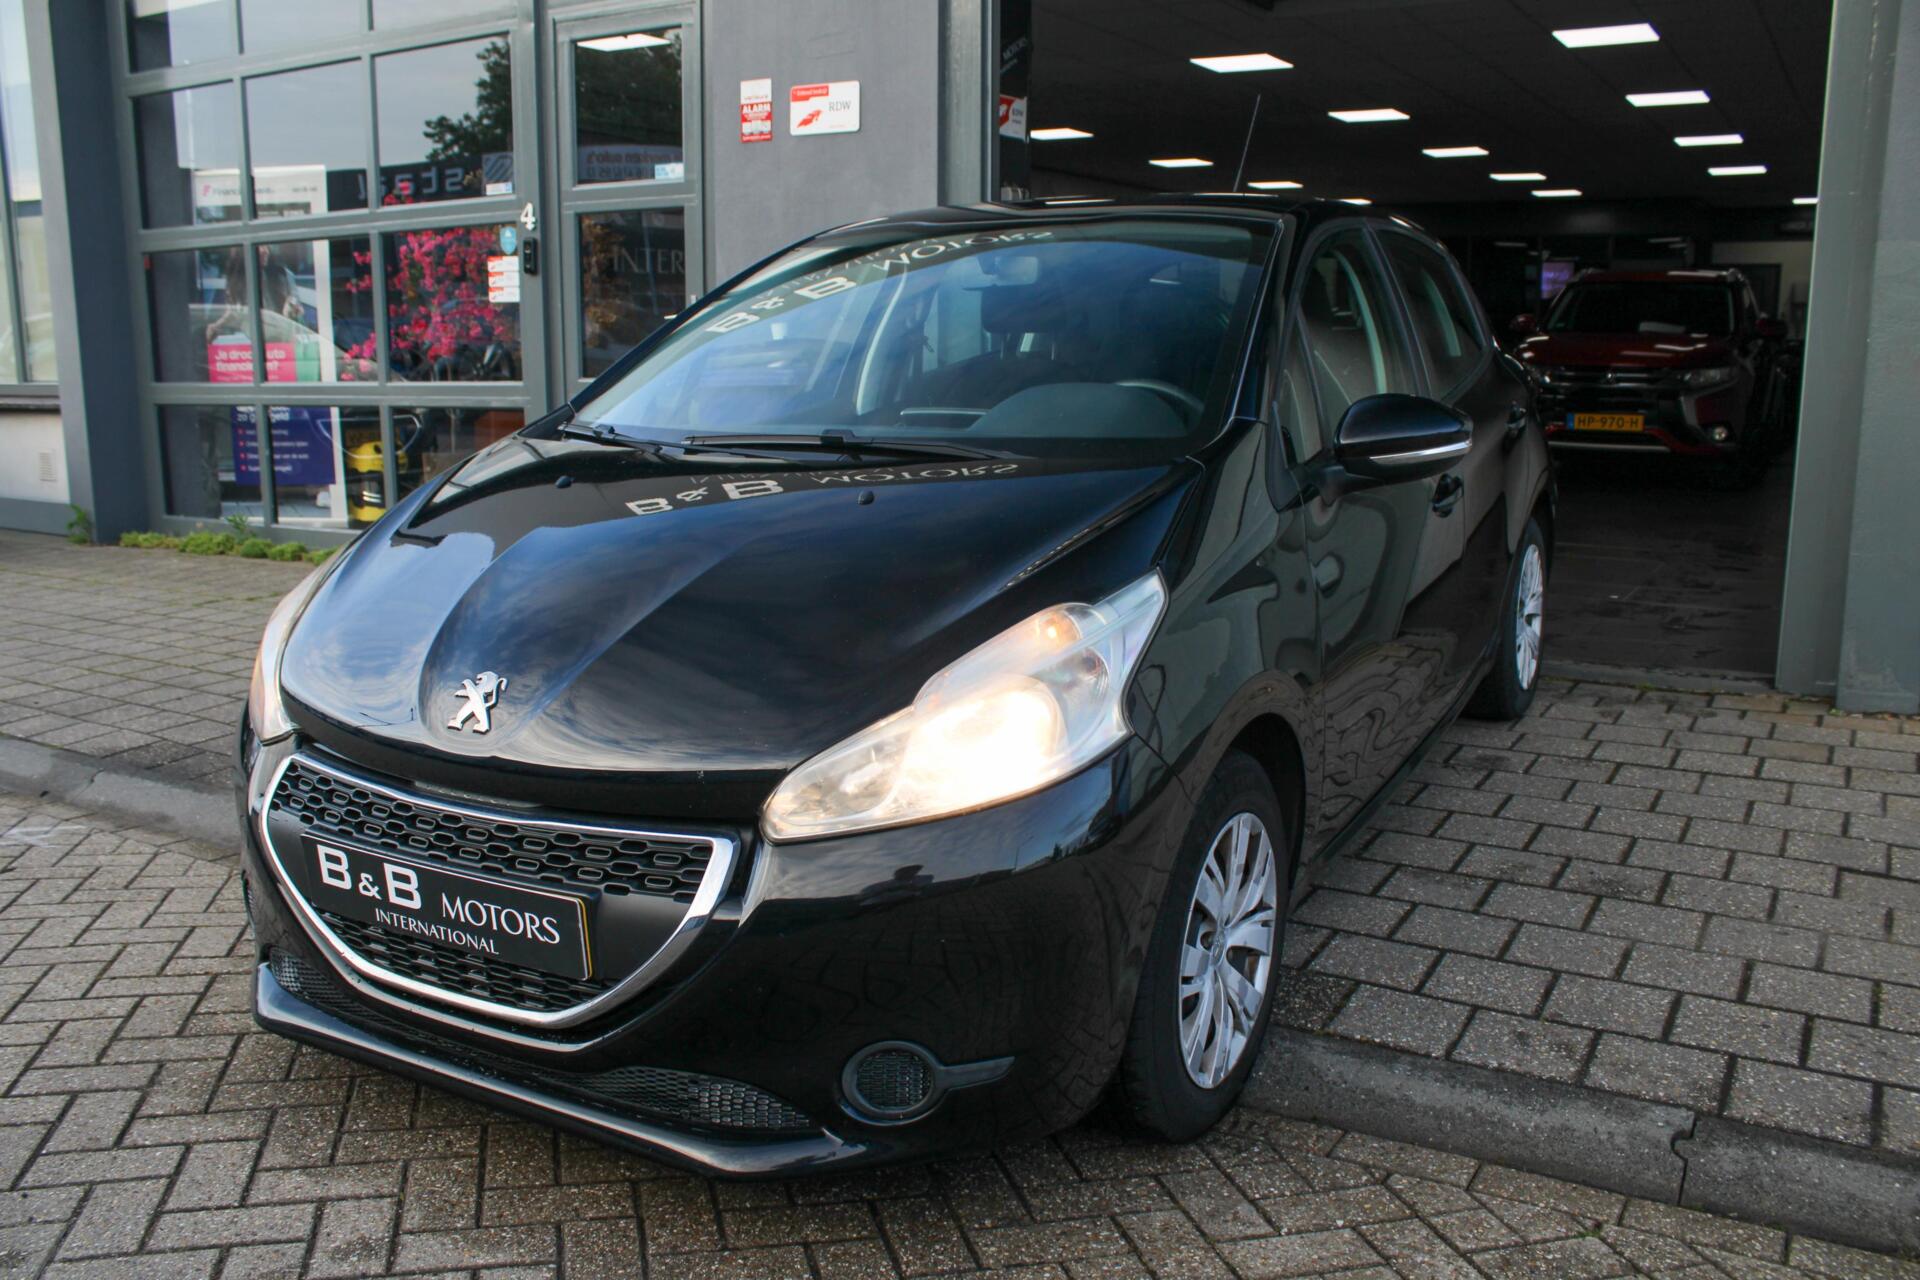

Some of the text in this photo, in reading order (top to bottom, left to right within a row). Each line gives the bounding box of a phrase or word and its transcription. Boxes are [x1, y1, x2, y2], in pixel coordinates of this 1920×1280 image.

[742, 102, 771, 114] ALARM
[829, 100, 851, 112] RDW
[520, 202, 535, 231] 4
[375, 907, 500, 955] INTERNATIONAL
[442, 892, 561, 944] MOTORS
